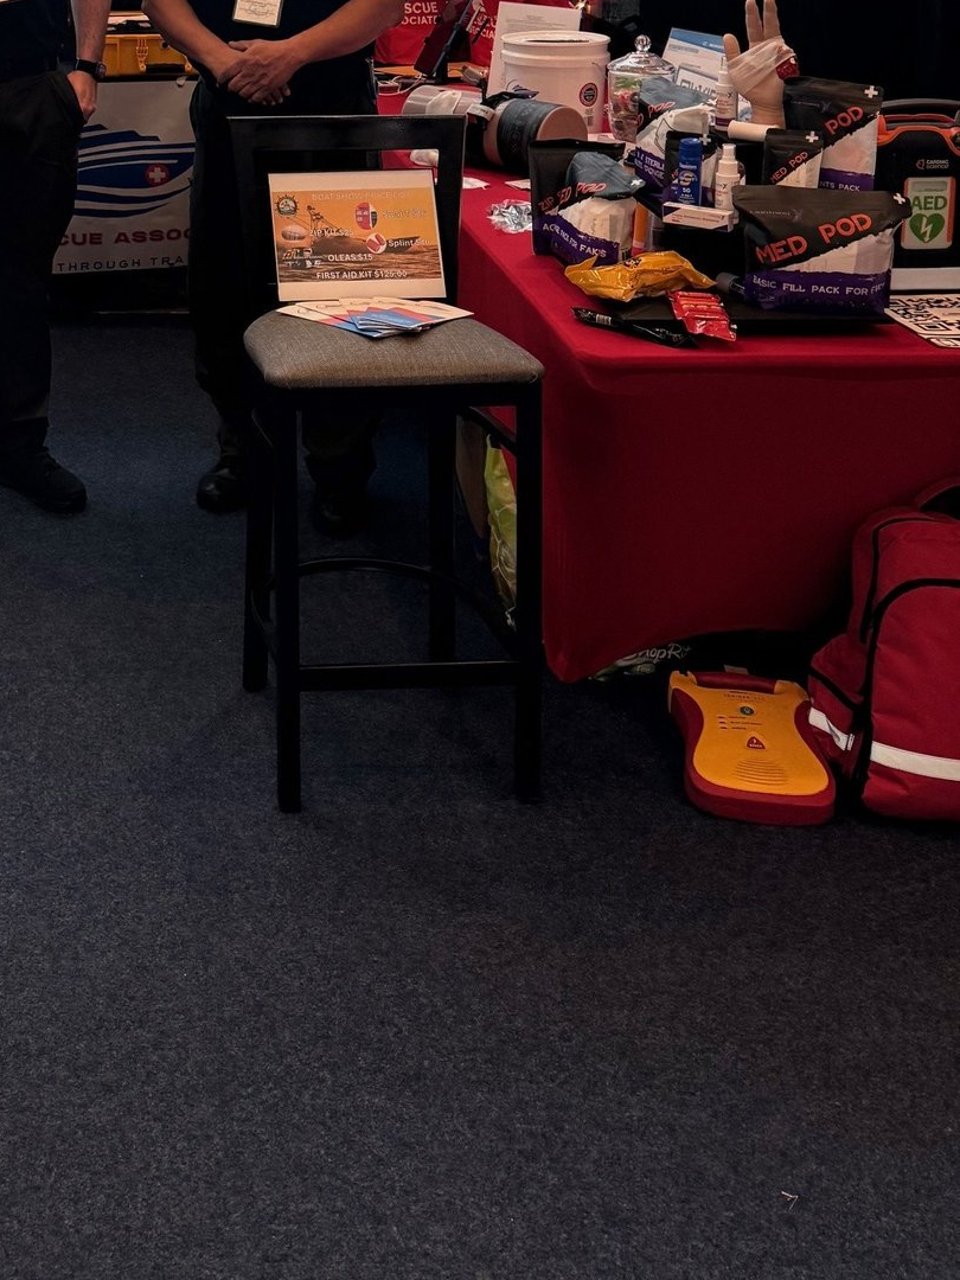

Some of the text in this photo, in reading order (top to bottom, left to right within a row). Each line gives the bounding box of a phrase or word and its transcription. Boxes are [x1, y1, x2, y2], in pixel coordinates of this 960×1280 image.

[404, 2, 439, 14] SCUE
[824, 106, 864, 135] POD
[789, 151, 808, 168] POD
[912, 195, 948, 211] AED
[755, 213, 873, 264] MED POD
[57, 258, 141, 272] THROUGH
[783, 282, 806, 293] FILL
[811, 284, 840, 295] PACK
[845, 286, 869, 296] FOR
